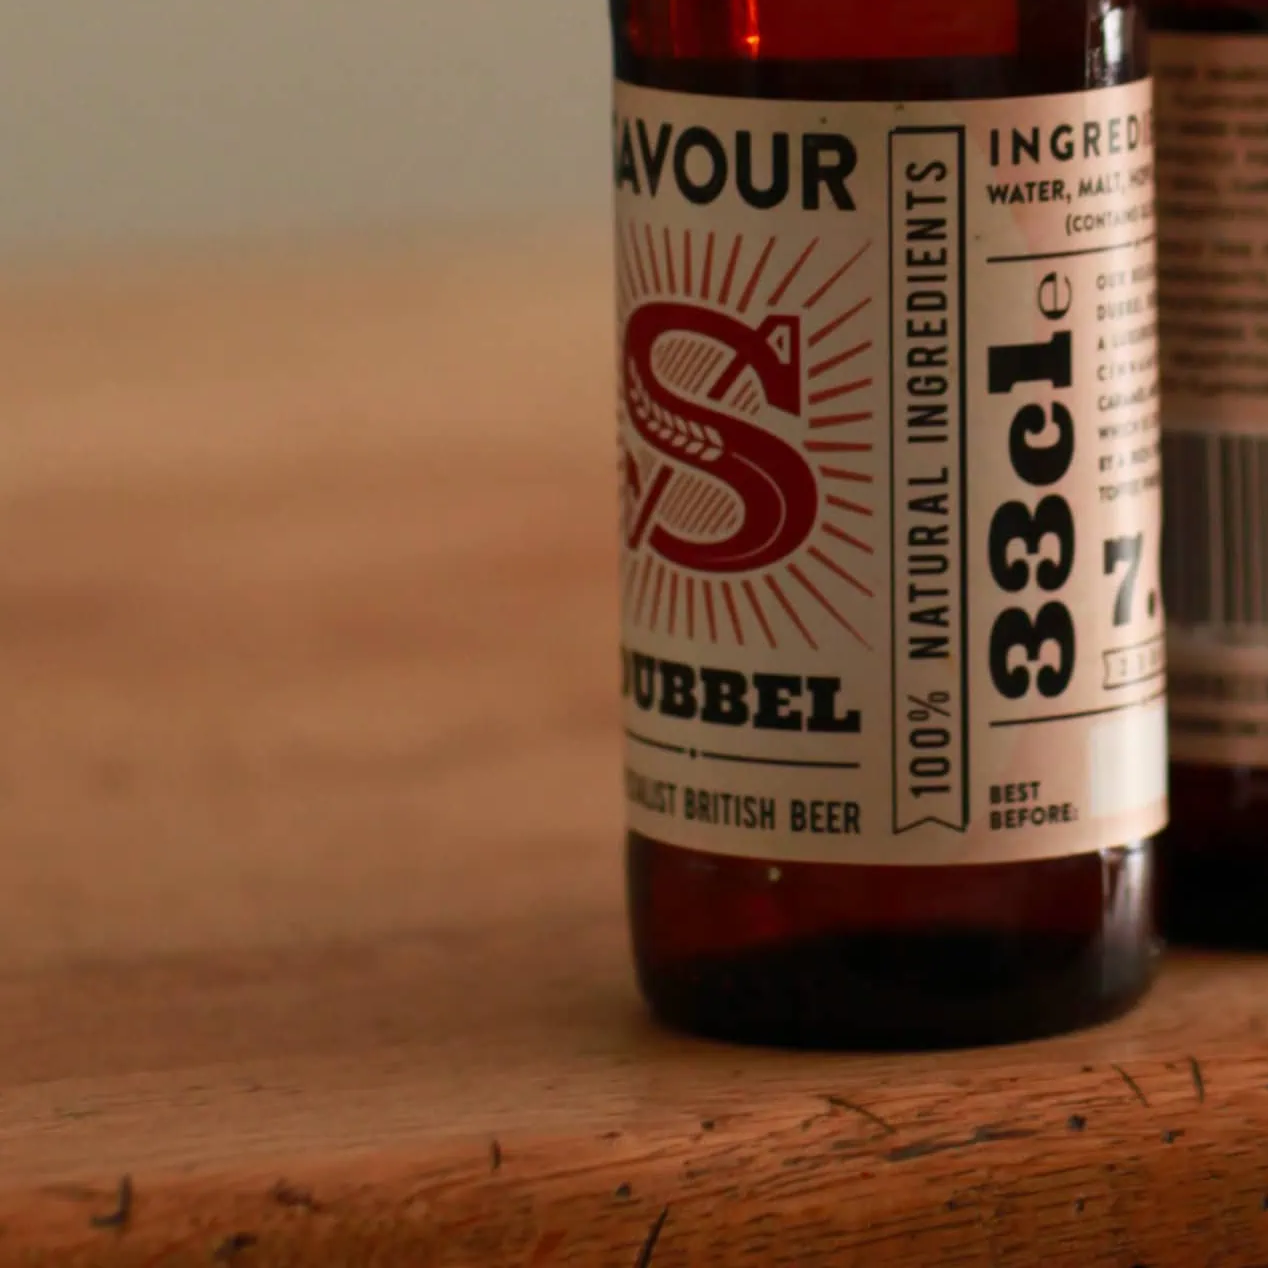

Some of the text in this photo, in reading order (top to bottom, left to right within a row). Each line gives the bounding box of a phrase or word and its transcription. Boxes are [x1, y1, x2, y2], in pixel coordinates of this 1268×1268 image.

[613, 114, 858, 211] AVOUR
[987, 180, 1072, 205] WATER,
[906, 160, 951, 798] 100% NATURAL INGREDIENTS
[683, 786, 776, 831] BRITISH
[790, 798, 862, 835] BEER
[989, 782, 1041, 805] BEST
